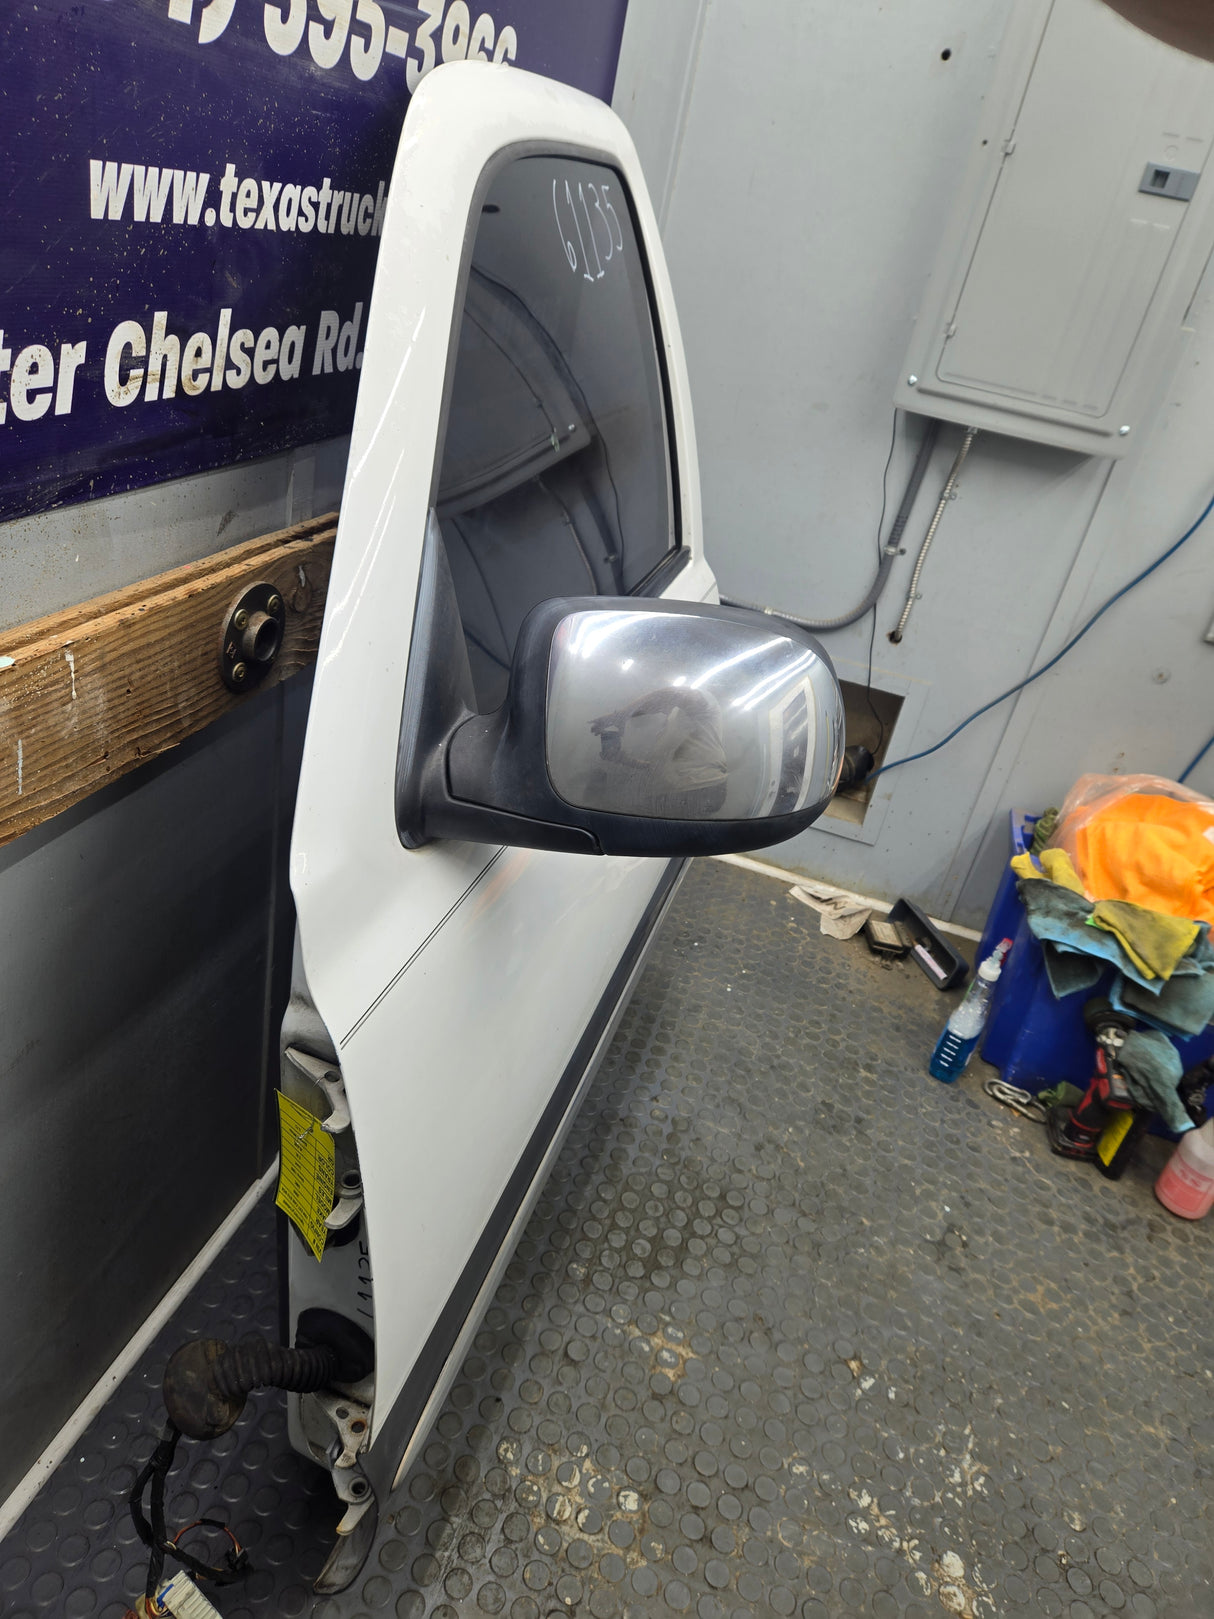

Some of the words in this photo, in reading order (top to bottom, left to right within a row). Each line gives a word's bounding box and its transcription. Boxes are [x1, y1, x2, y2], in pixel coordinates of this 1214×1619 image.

[552, 178, 624, 282] 61135
[104, 308, 307, 408] Chelsea
[312, 302, 364, 375] Rd.
